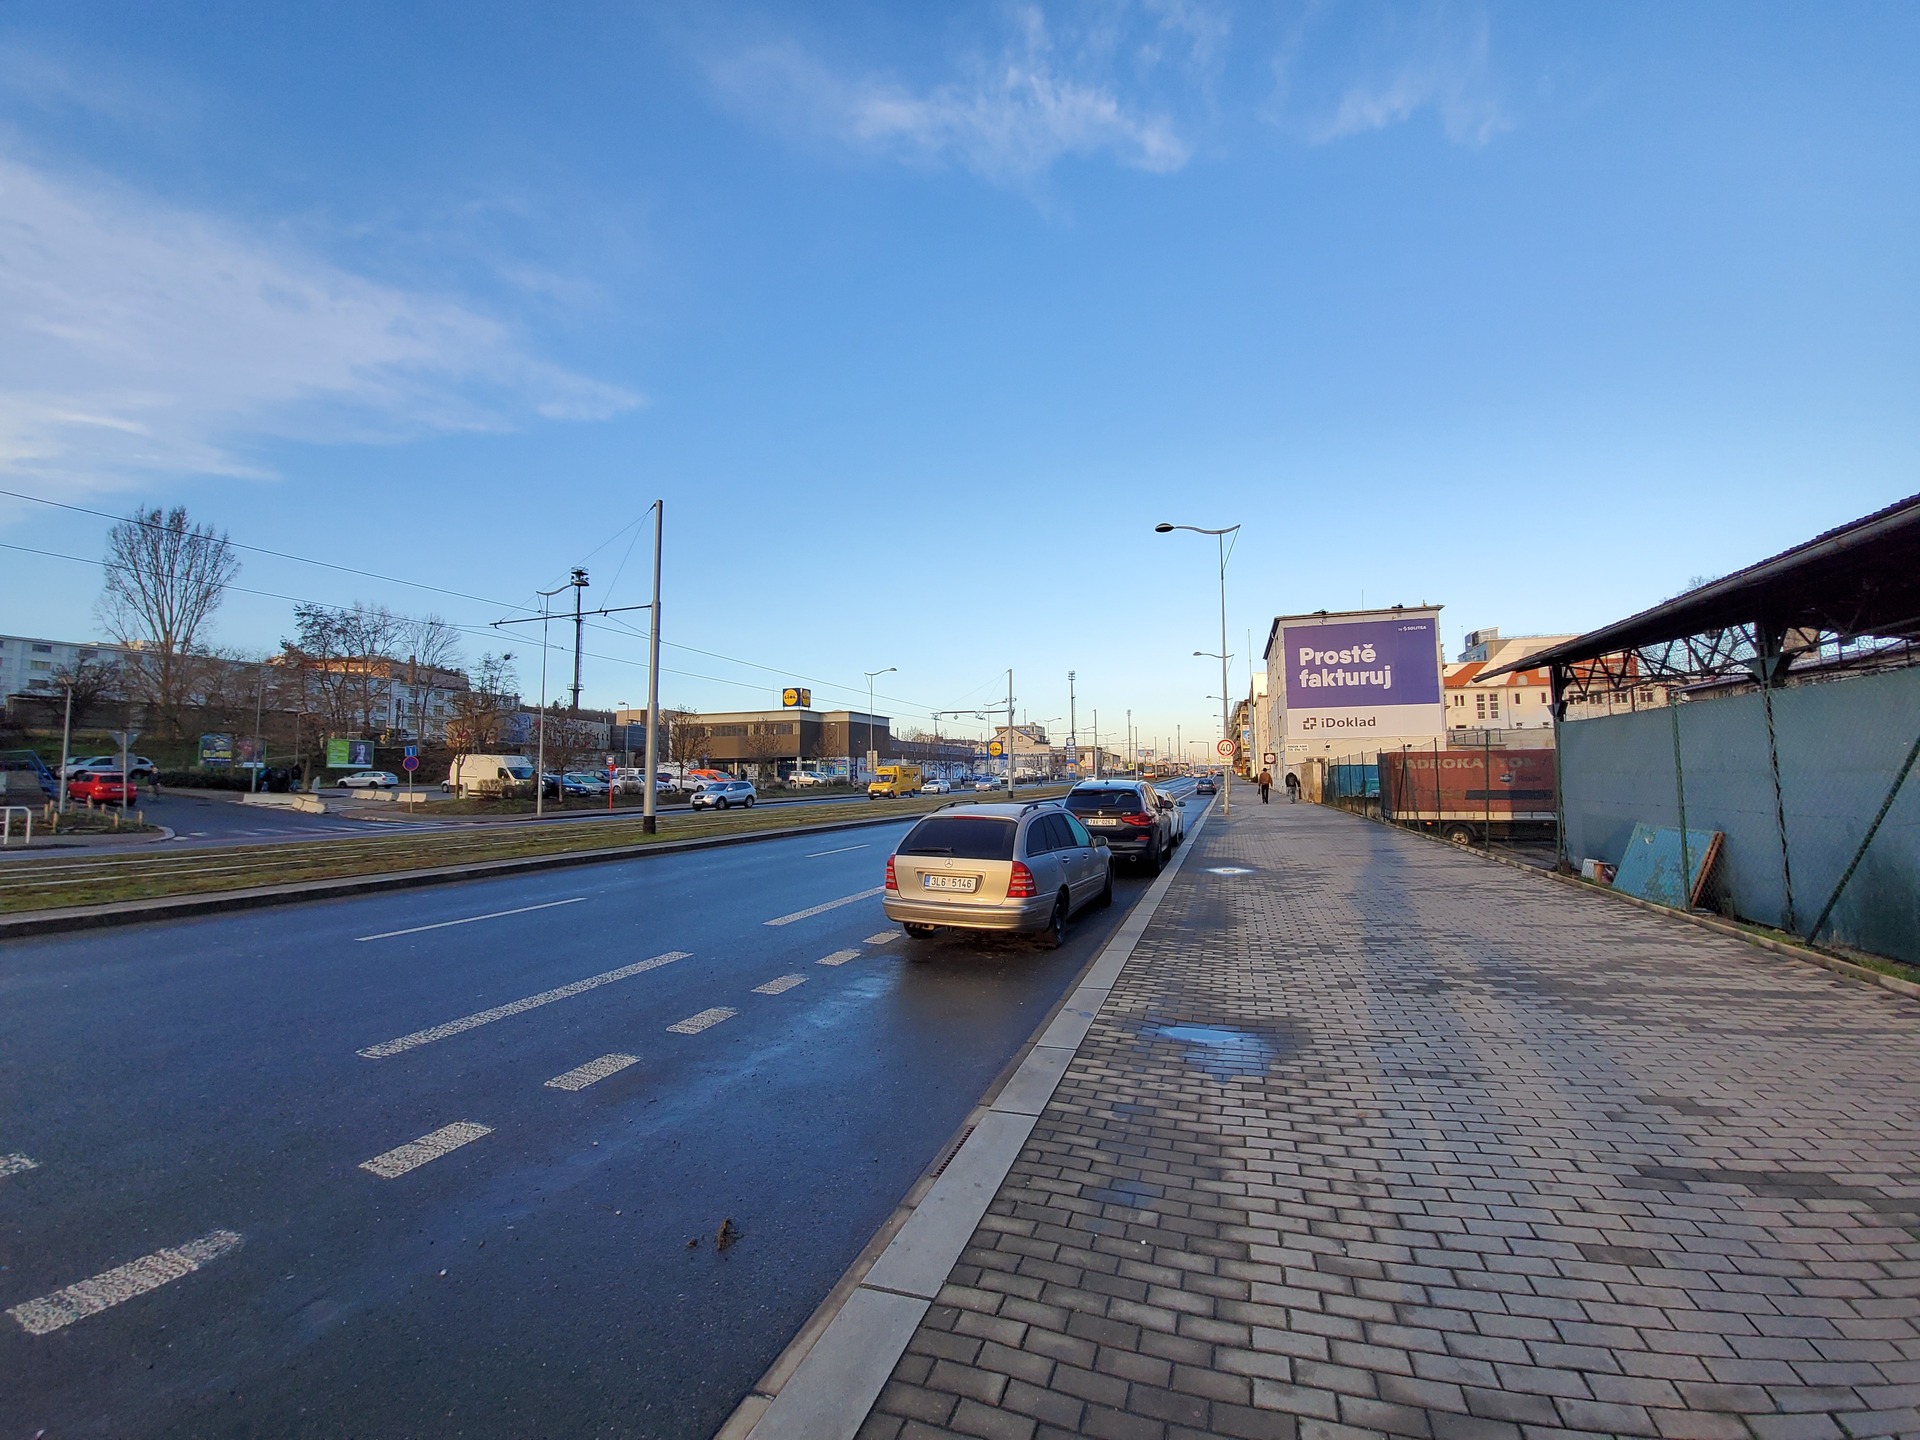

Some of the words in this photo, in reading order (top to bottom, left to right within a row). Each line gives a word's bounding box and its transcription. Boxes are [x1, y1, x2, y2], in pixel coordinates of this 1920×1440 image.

[1299, 643, 1377, 666] Prostě
[1299, 665, 1392, 690] fakturuj
[1321, 716, 1376, 729] iDoklad
[1220, 743, 1232, 752] 40
[931, 877, 946, 887] 3L6
[951, 878, 972, 888] 5146
